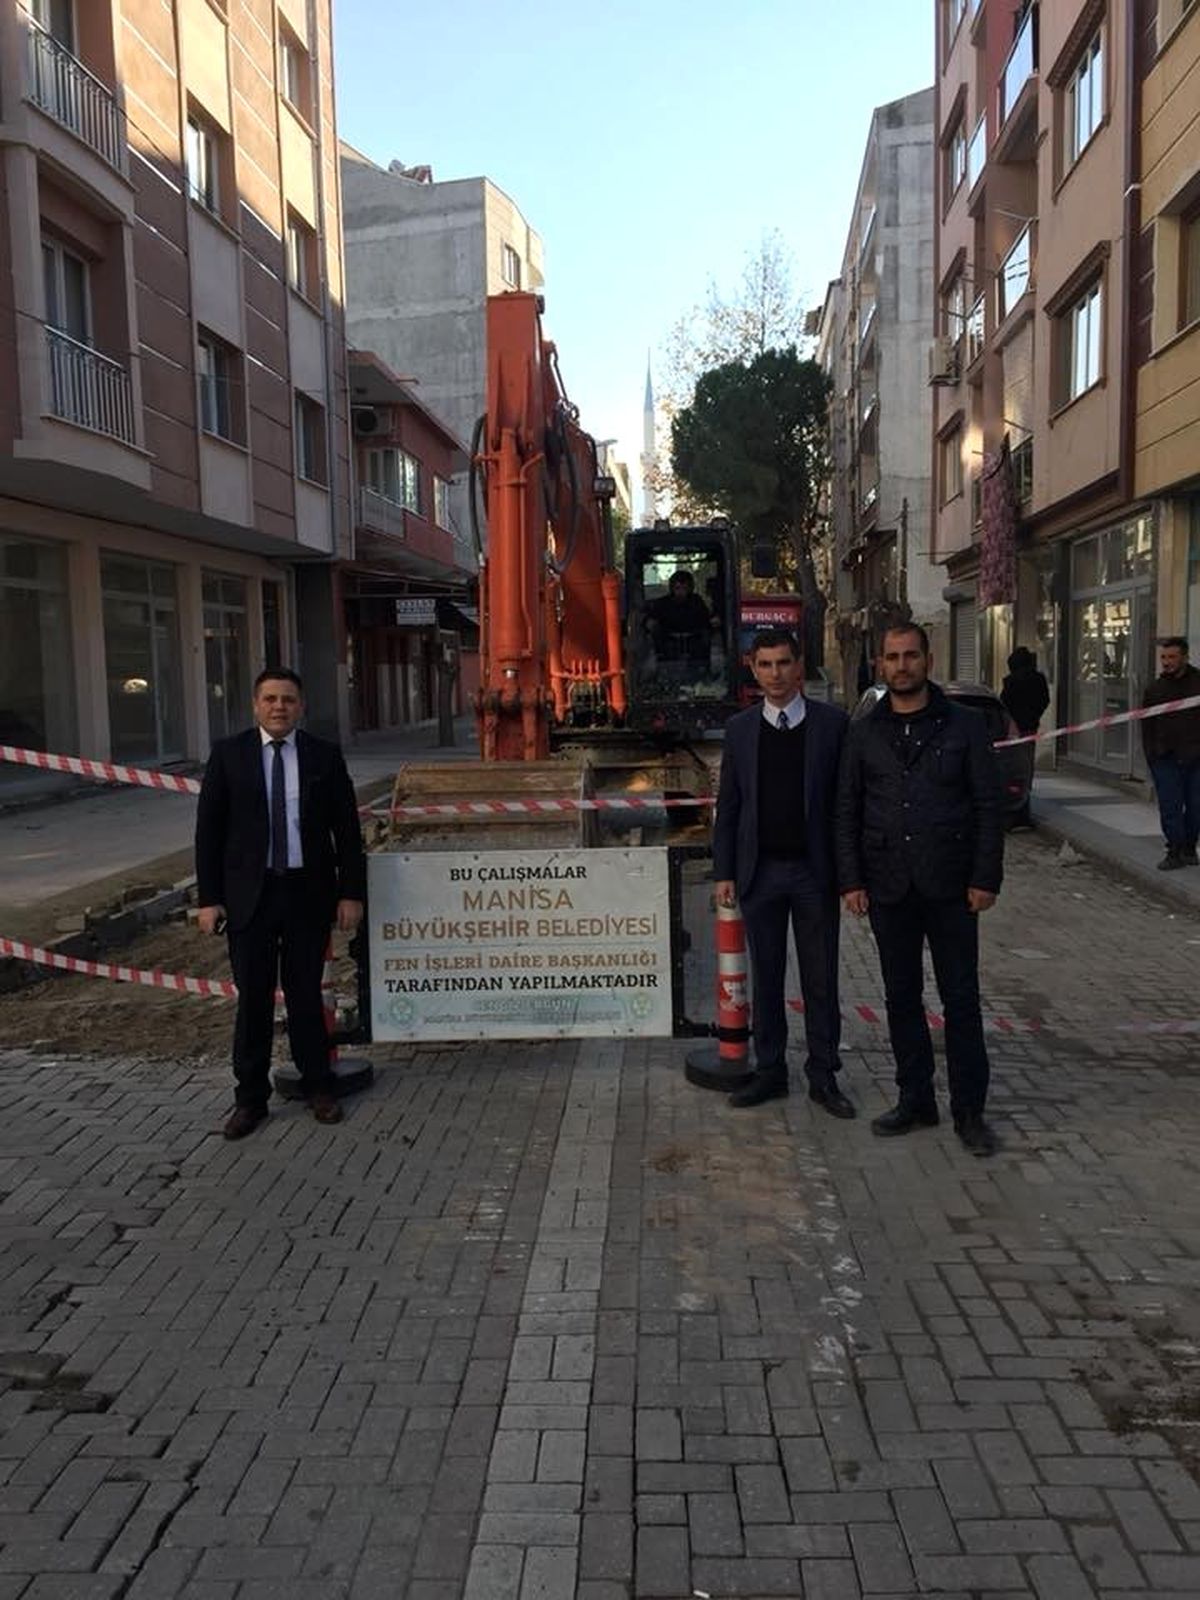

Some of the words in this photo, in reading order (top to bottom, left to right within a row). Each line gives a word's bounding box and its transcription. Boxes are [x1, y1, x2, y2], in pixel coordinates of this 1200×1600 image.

[450, 868, 472, 881] BU
[478, 866, 587, 883] ÇALIŞMALAR
[463, 885, 574, 911] MANİSA
[383, 915, 530, 943] BÜYÜKŞEHİR
[537, 913, 657, 937] BELEDİYESİ
[384, 958, 418, 971] FEN
[426, 953, 482, 972] İŞLERİ
[489, 952, 543, 969] DAİRE
[548, 950, 657, 969] BAŞKANLIĞI
[384, 976, 503, 993] TARAFINDAN
[509, 974, 658, 990] YAPILMAKTADIR
